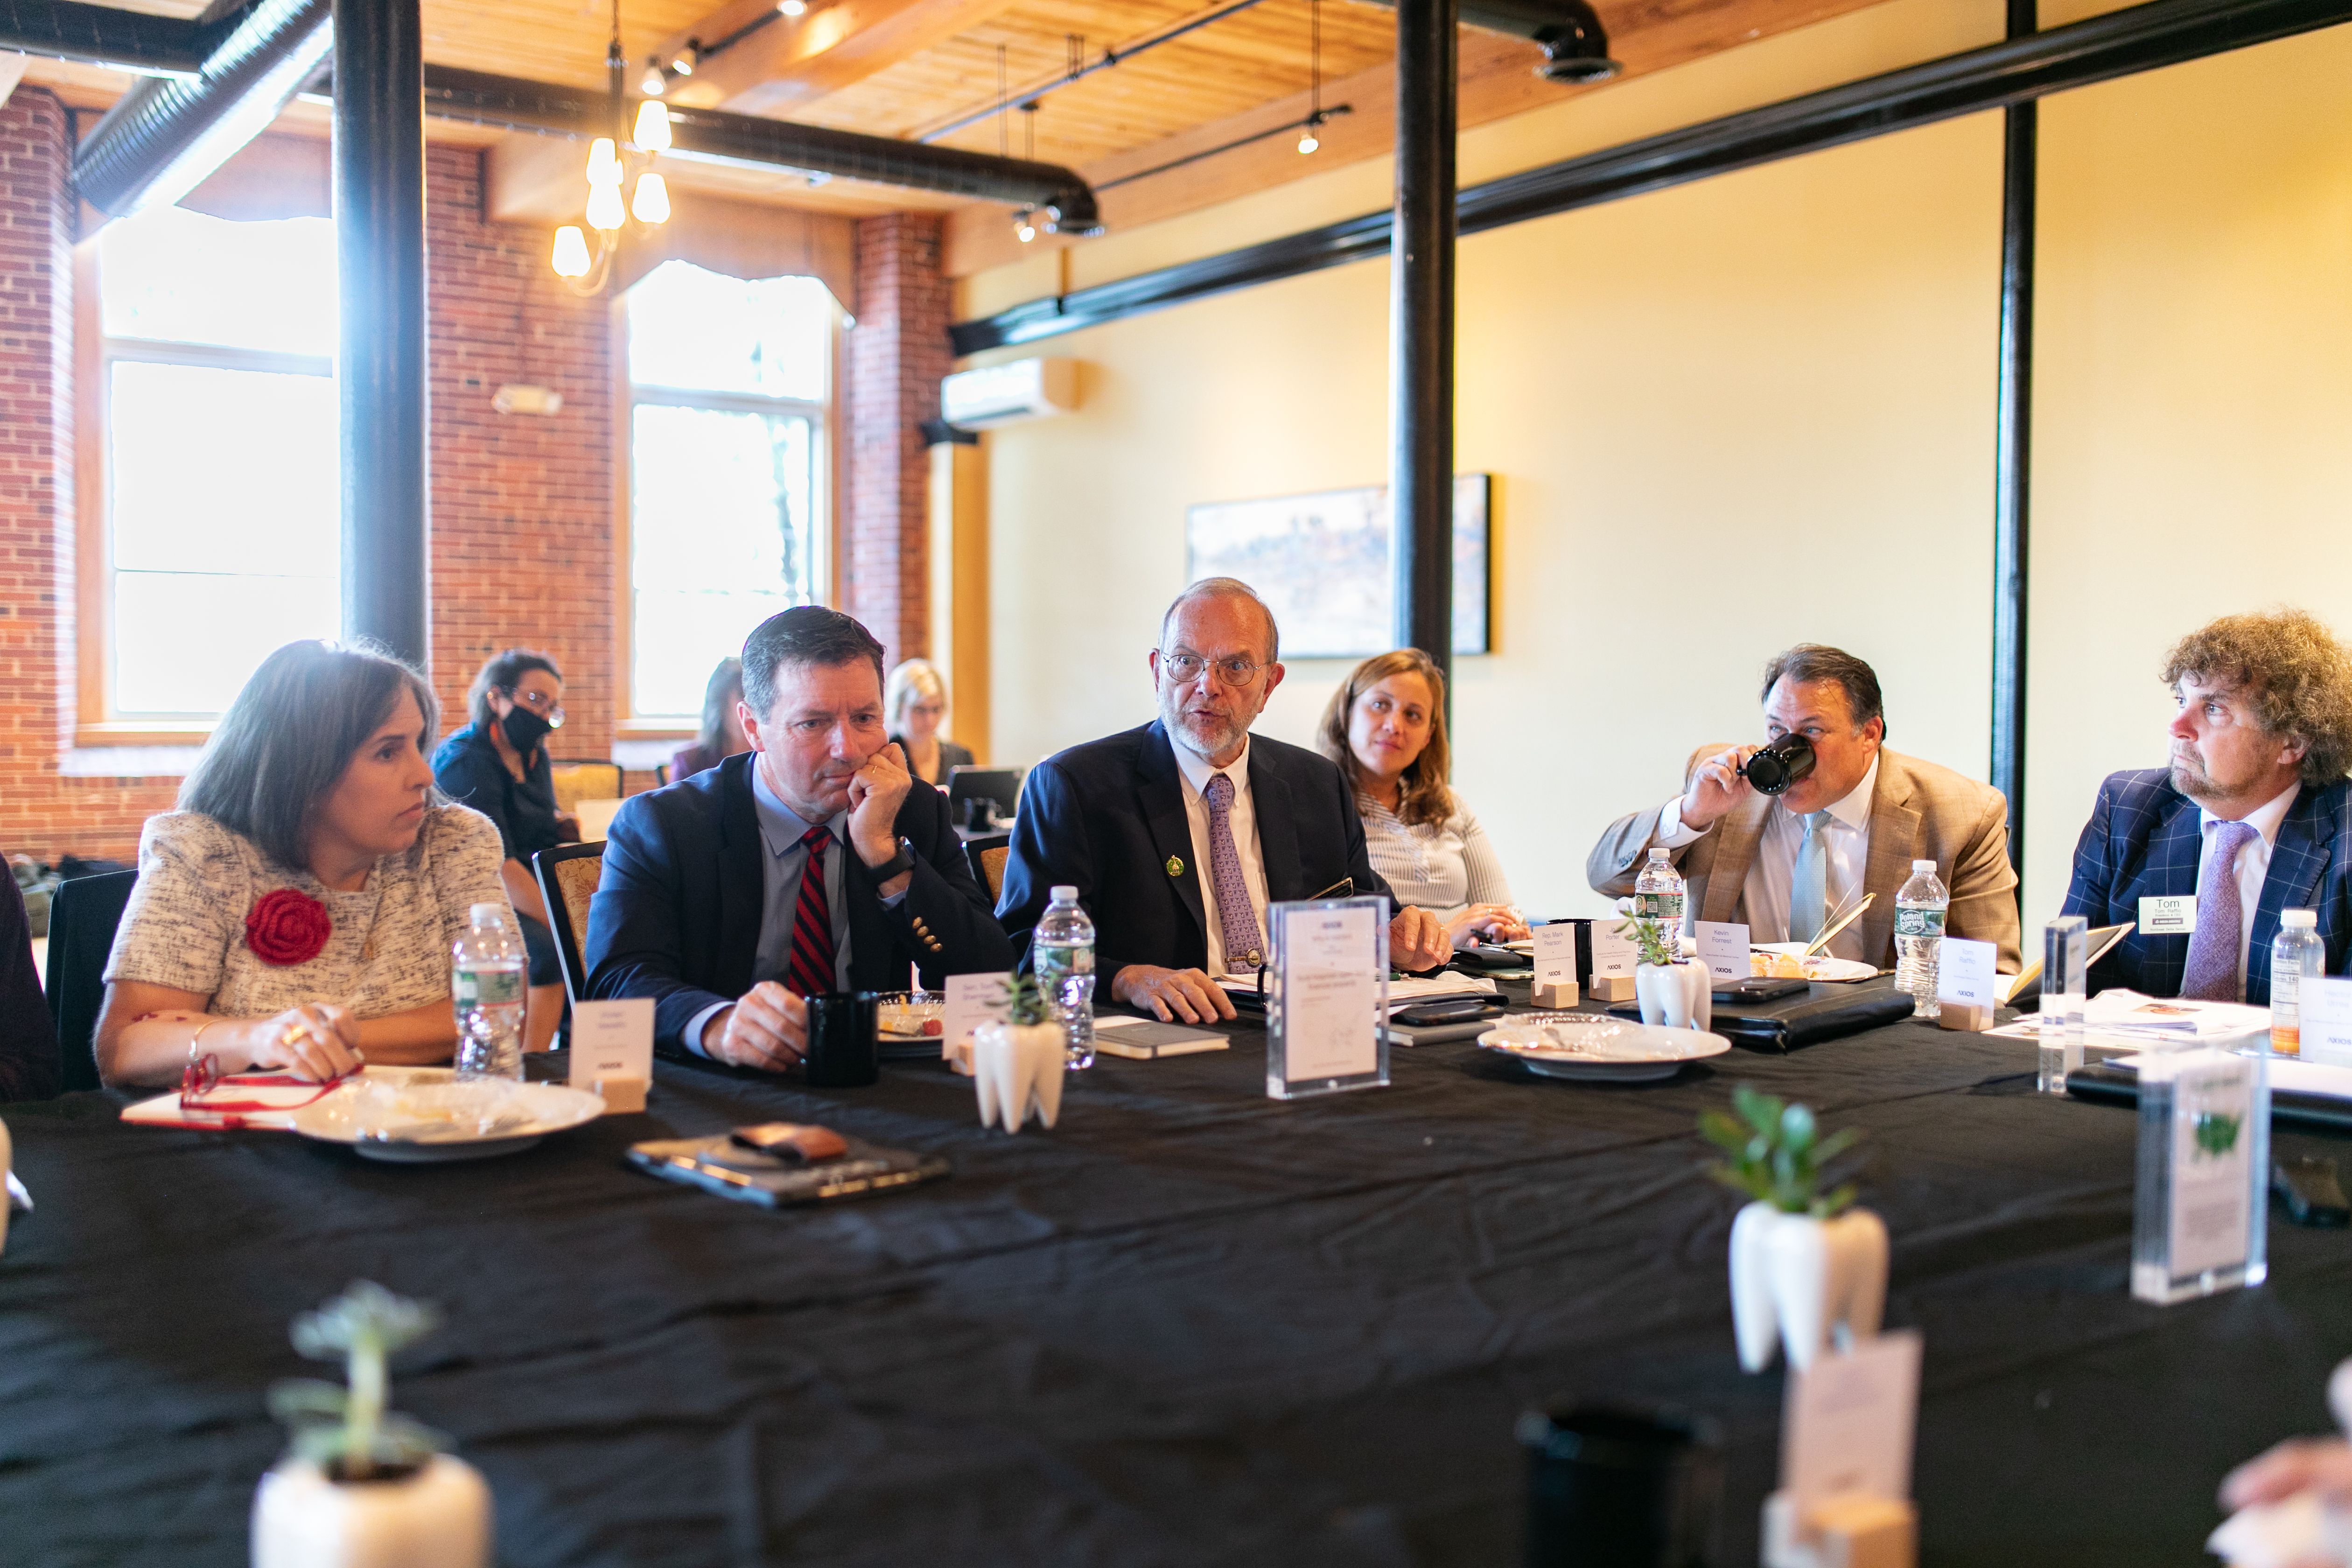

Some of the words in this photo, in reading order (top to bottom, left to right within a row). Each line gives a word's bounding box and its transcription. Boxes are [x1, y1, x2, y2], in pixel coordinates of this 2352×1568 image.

[2156, 899, 2179, 908] Tom
[1899, 911, 1924, 921] Poland
[1900, 920, 1925, 931] Spring
[2327, 1036, 2352, 1045] AXIOS
